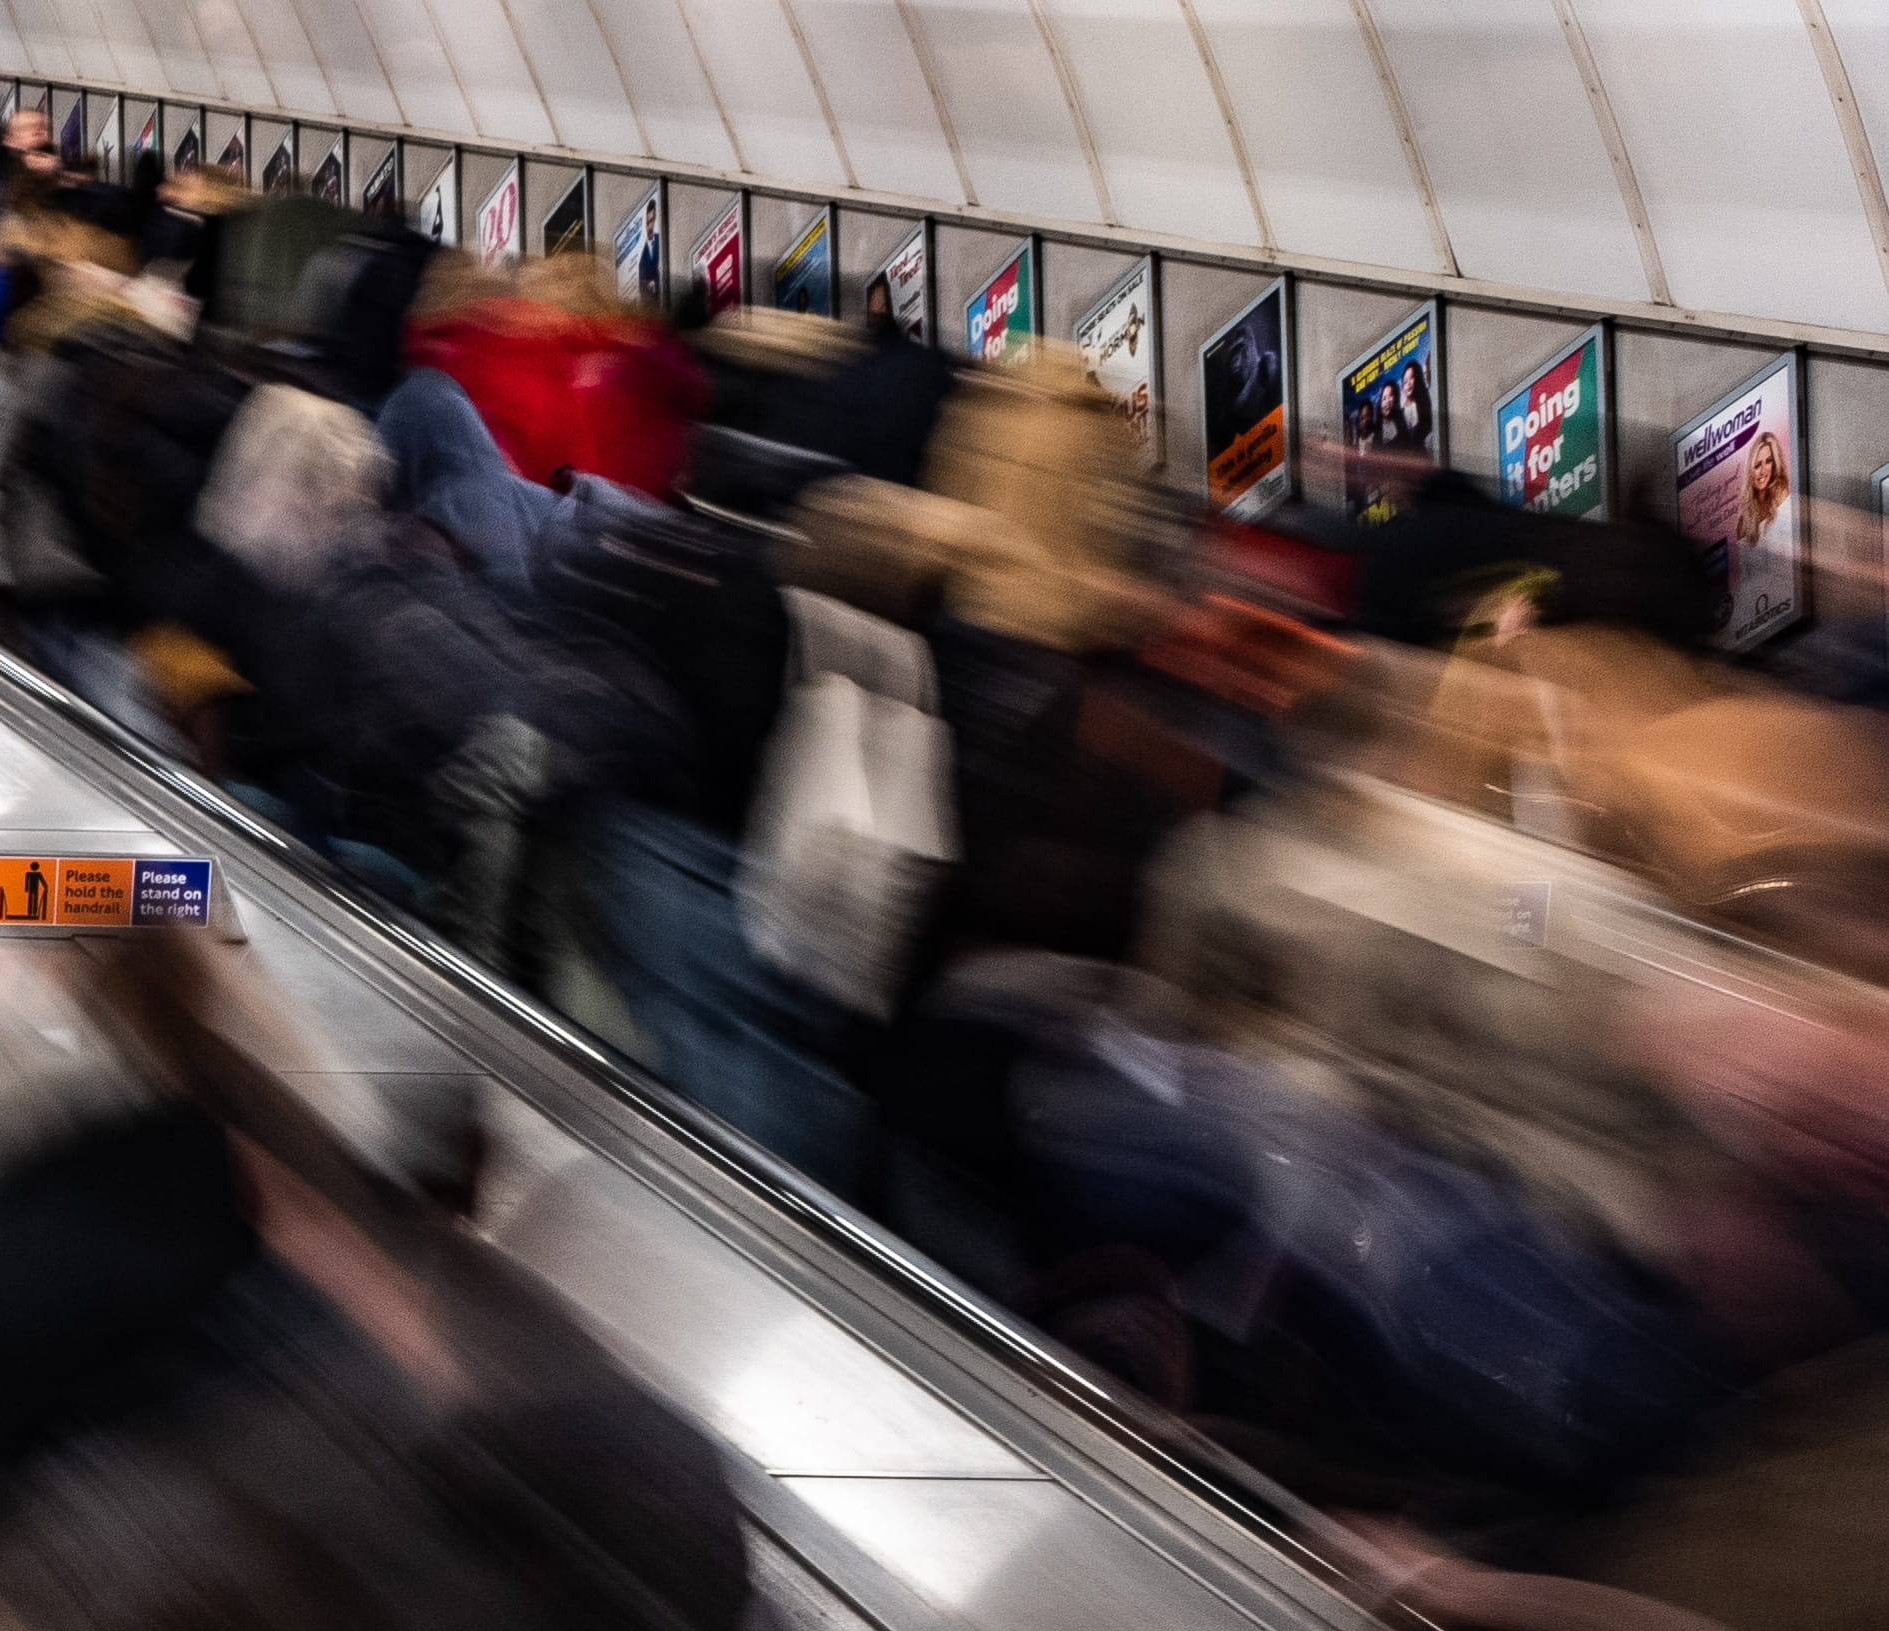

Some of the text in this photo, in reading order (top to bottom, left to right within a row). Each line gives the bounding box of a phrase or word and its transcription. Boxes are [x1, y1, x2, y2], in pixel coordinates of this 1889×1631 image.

[972, 283, 1019, 346] Doing
[1504, 378, 1580, 454] Doing
[1683, 397, 1762, 467] wellwoman
[1528, 434, 1565, 481] for
[65, 870, 110, 883] Please
[141, 871, 187, 885] Please
[65, 886, 123, 900] hold the
[141, 888, 201, 900] stand on
[64, 901, 121, 914] handrail
[141, 903, 201, 918] the right
